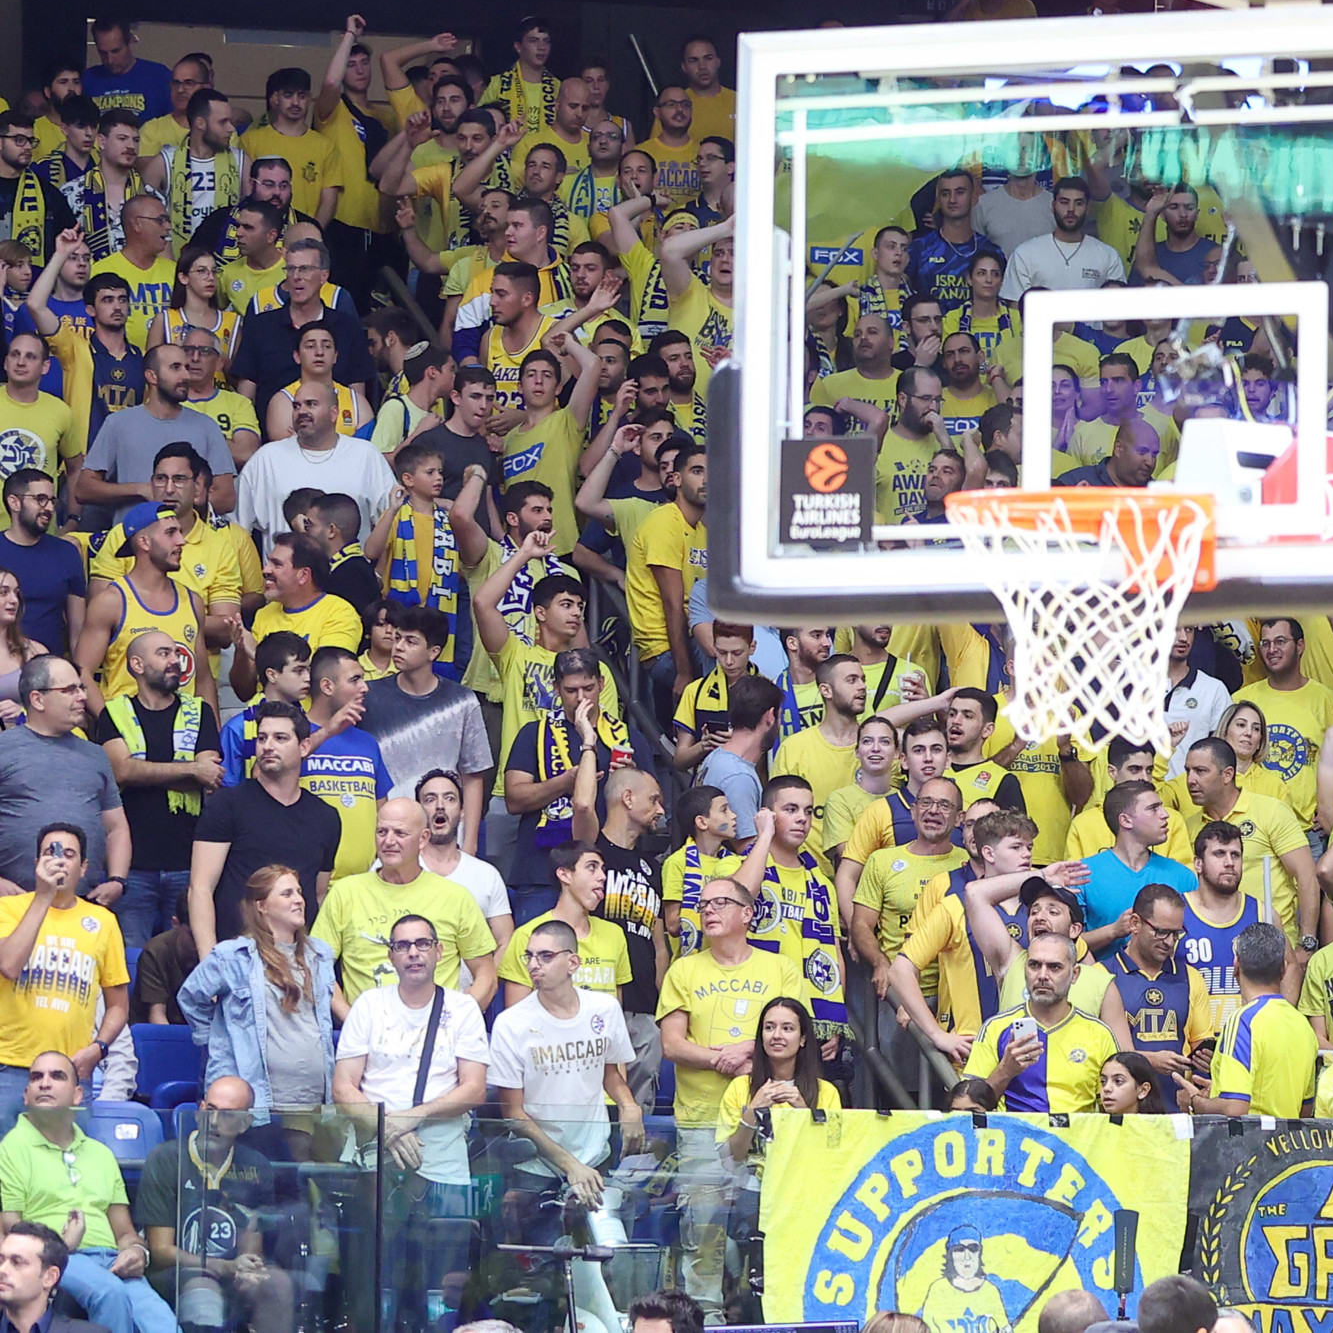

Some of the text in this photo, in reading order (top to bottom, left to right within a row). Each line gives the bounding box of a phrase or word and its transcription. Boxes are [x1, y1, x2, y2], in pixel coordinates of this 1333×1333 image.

[192, 170, 215, 191] 23
[792, 494, 860, 509] TURKISH
[791, 510, 860, 525] AIRLINES
[1186, 940, 1211, 964] 30
[694, 978, 767, 999] MACCABI
[1258, 1204, 1288, 1219] THE
[210, 1221, 231, 1239] 23
